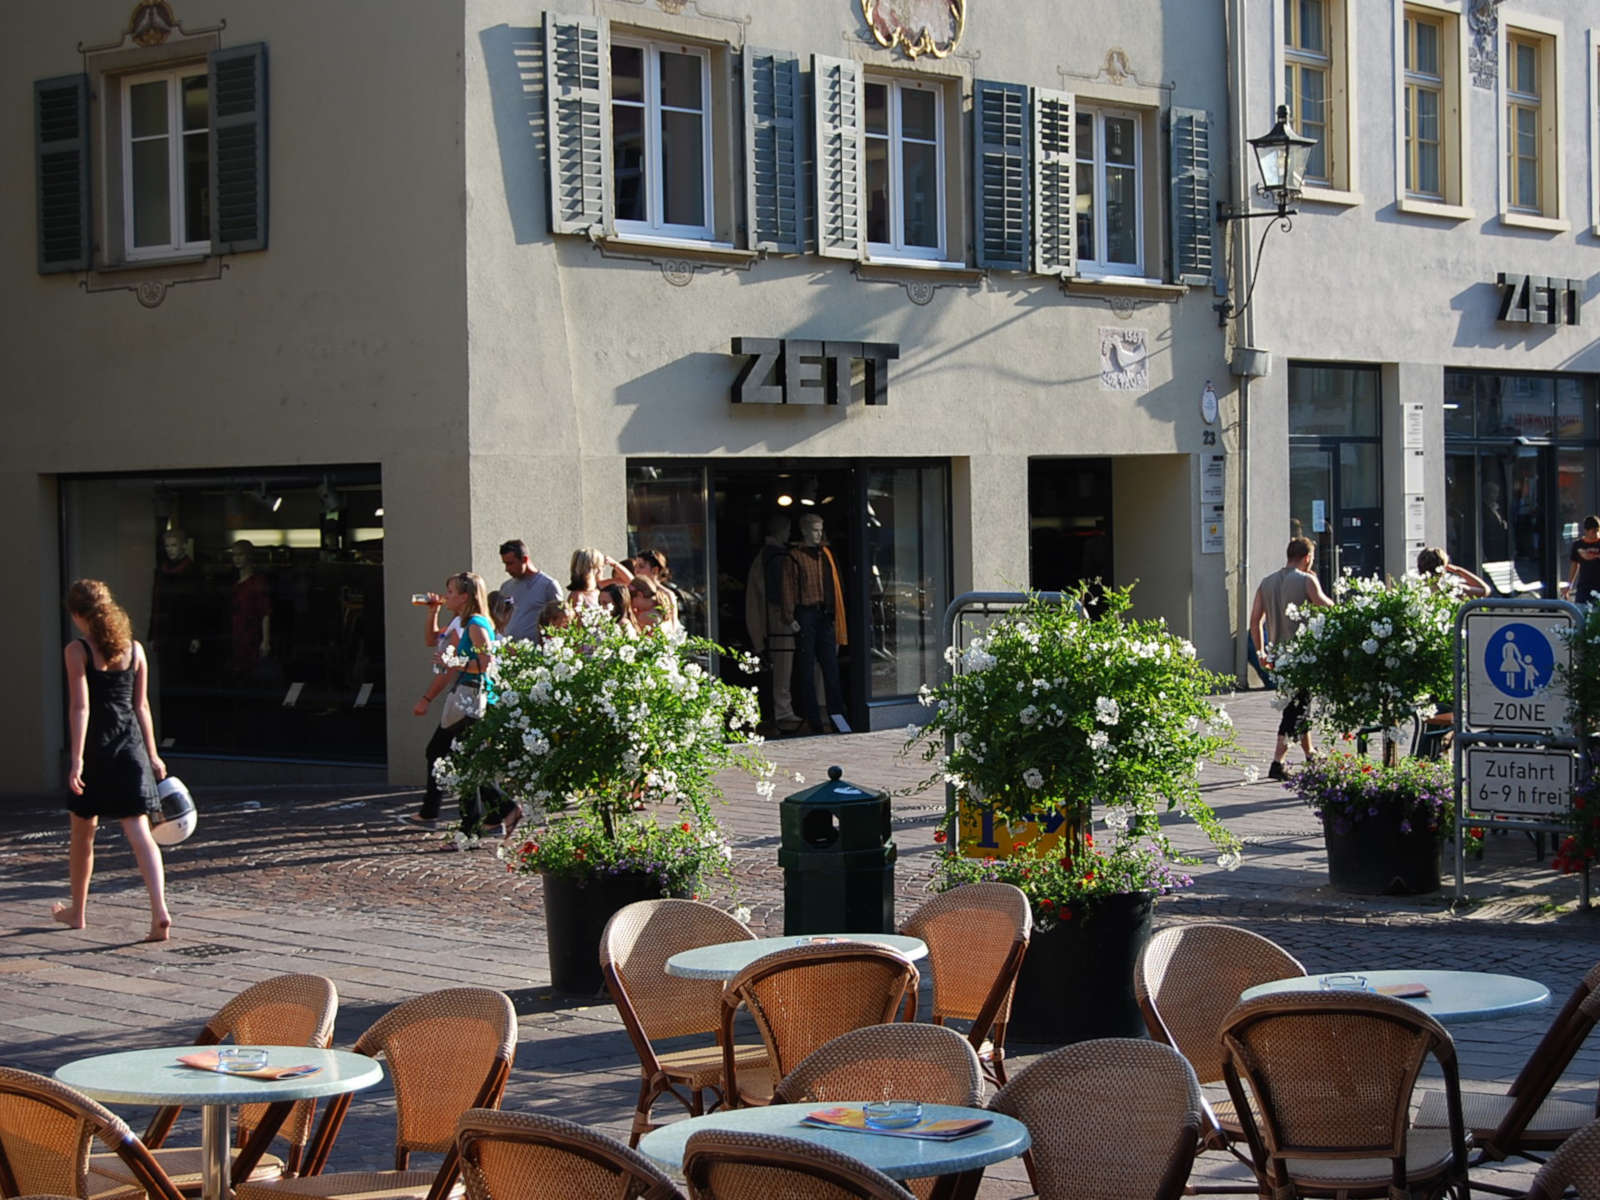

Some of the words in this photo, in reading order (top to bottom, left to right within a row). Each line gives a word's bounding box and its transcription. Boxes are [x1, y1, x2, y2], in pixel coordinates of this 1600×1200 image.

[1497, 272, 1584, 325] ZETT
[731, 337, 899, 405] ZETT
[1203, 430, 1216, 446] 23
[1493, 702, 1546, 721] ZONE
[1485, 760, 1555, 780] Zufahrt
[1518, 785, 1526, 803] h
[1532, 786, 1562, 805] frei
